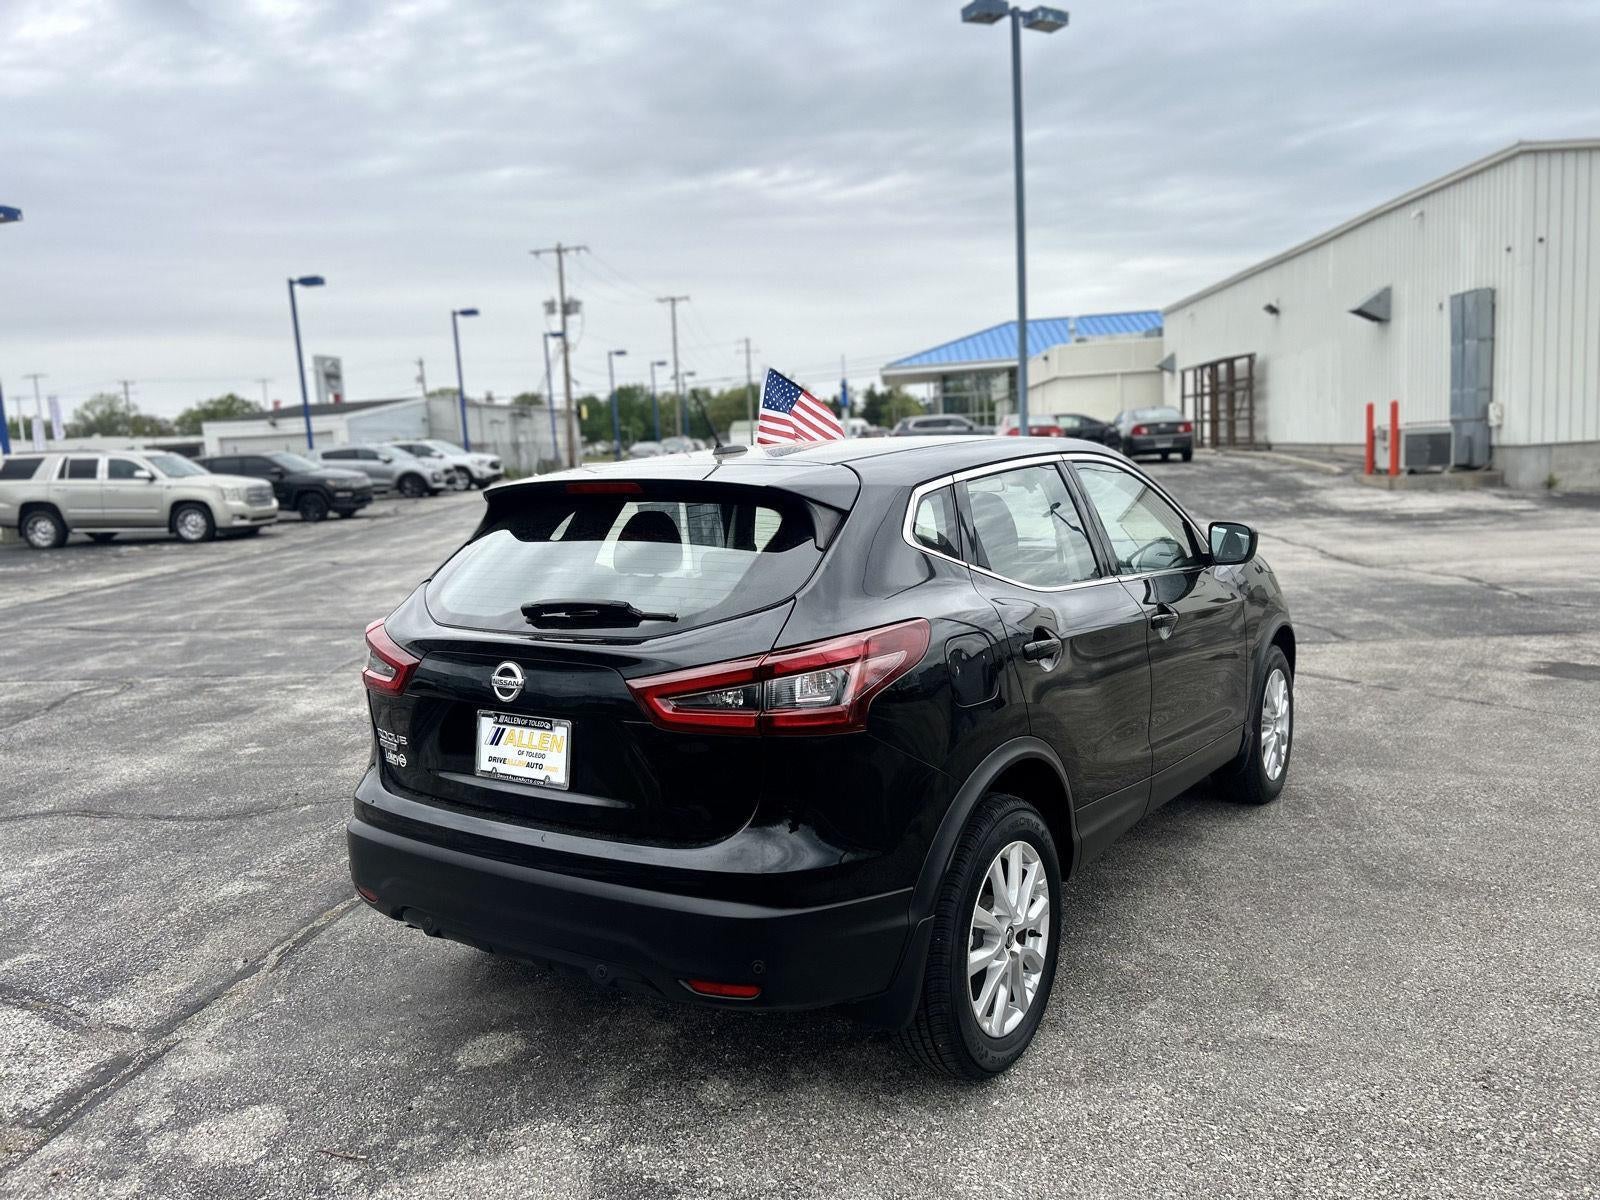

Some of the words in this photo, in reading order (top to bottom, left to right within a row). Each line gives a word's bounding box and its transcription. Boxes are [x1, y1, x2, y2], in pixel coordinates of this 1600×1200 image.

[504, 715, 521, 725] ALLEN
[521, 718, 528, 726] OF
[503, 728, 565, 753] ALLEN
[525, 750, 546, 760] TOLEDO
